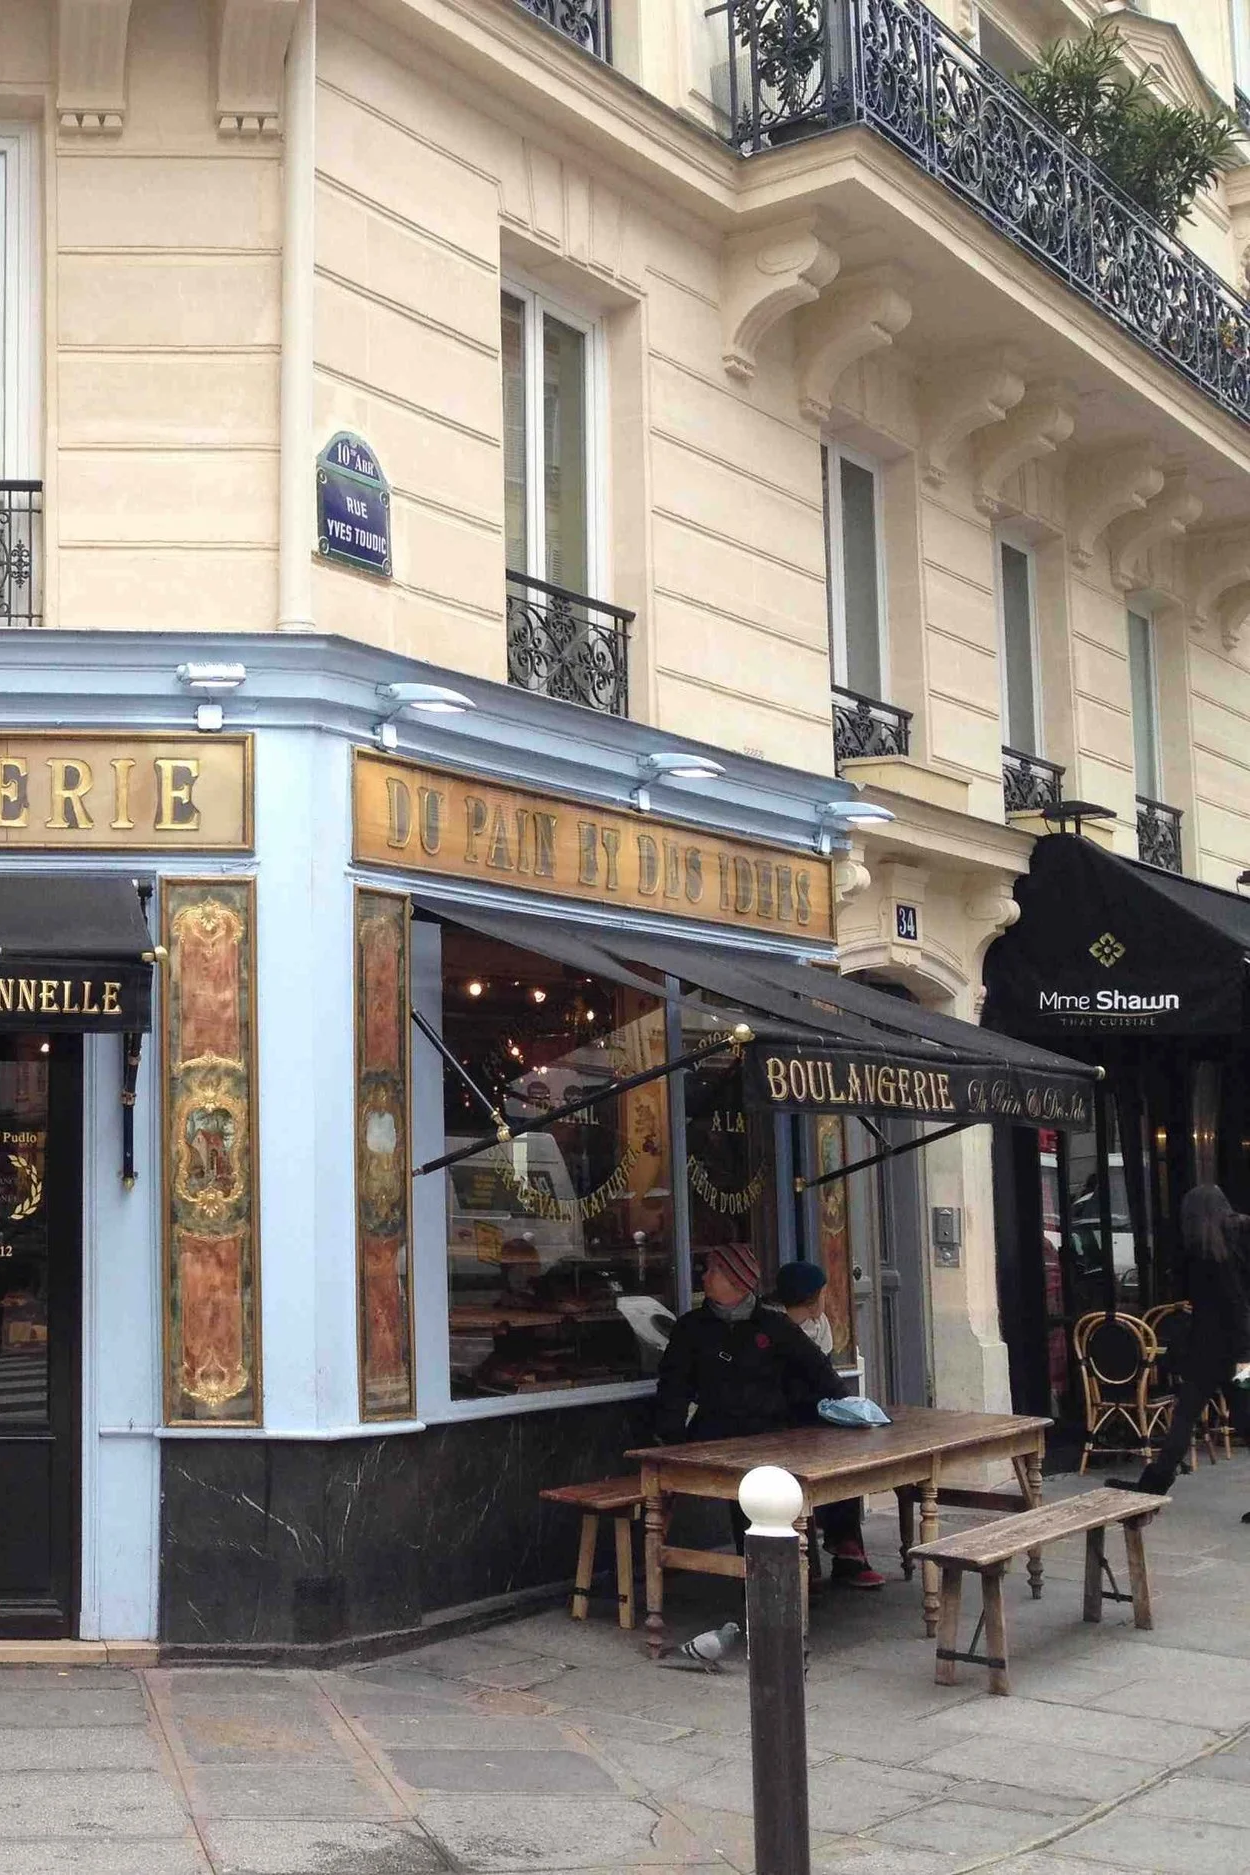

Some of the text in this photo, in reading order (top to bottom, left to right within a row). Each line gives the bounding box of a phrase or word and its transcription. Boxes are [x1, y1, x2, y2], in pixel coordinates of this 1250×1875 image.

[346, 496, 368, 519] RUE
[327, 519, 387, 555] YVES TOUDIC
[385, 777, 444, 855] DU
[464, 795, 559, 875] PAIN
[576, 821, 622, 890] ET
[636, 833, 704, 903] DES
[899, 908, 916, 938] 34
[1039, 989, 1180, 1010] Mme Shawn
[1100, 1017, 1157, 1027] CUISINE
[766, 1057, 956, 1113] BOULANGERIE
[726, 1110, 746, 1134] LA
[3, 1131, 38, 1143] Pudlo
